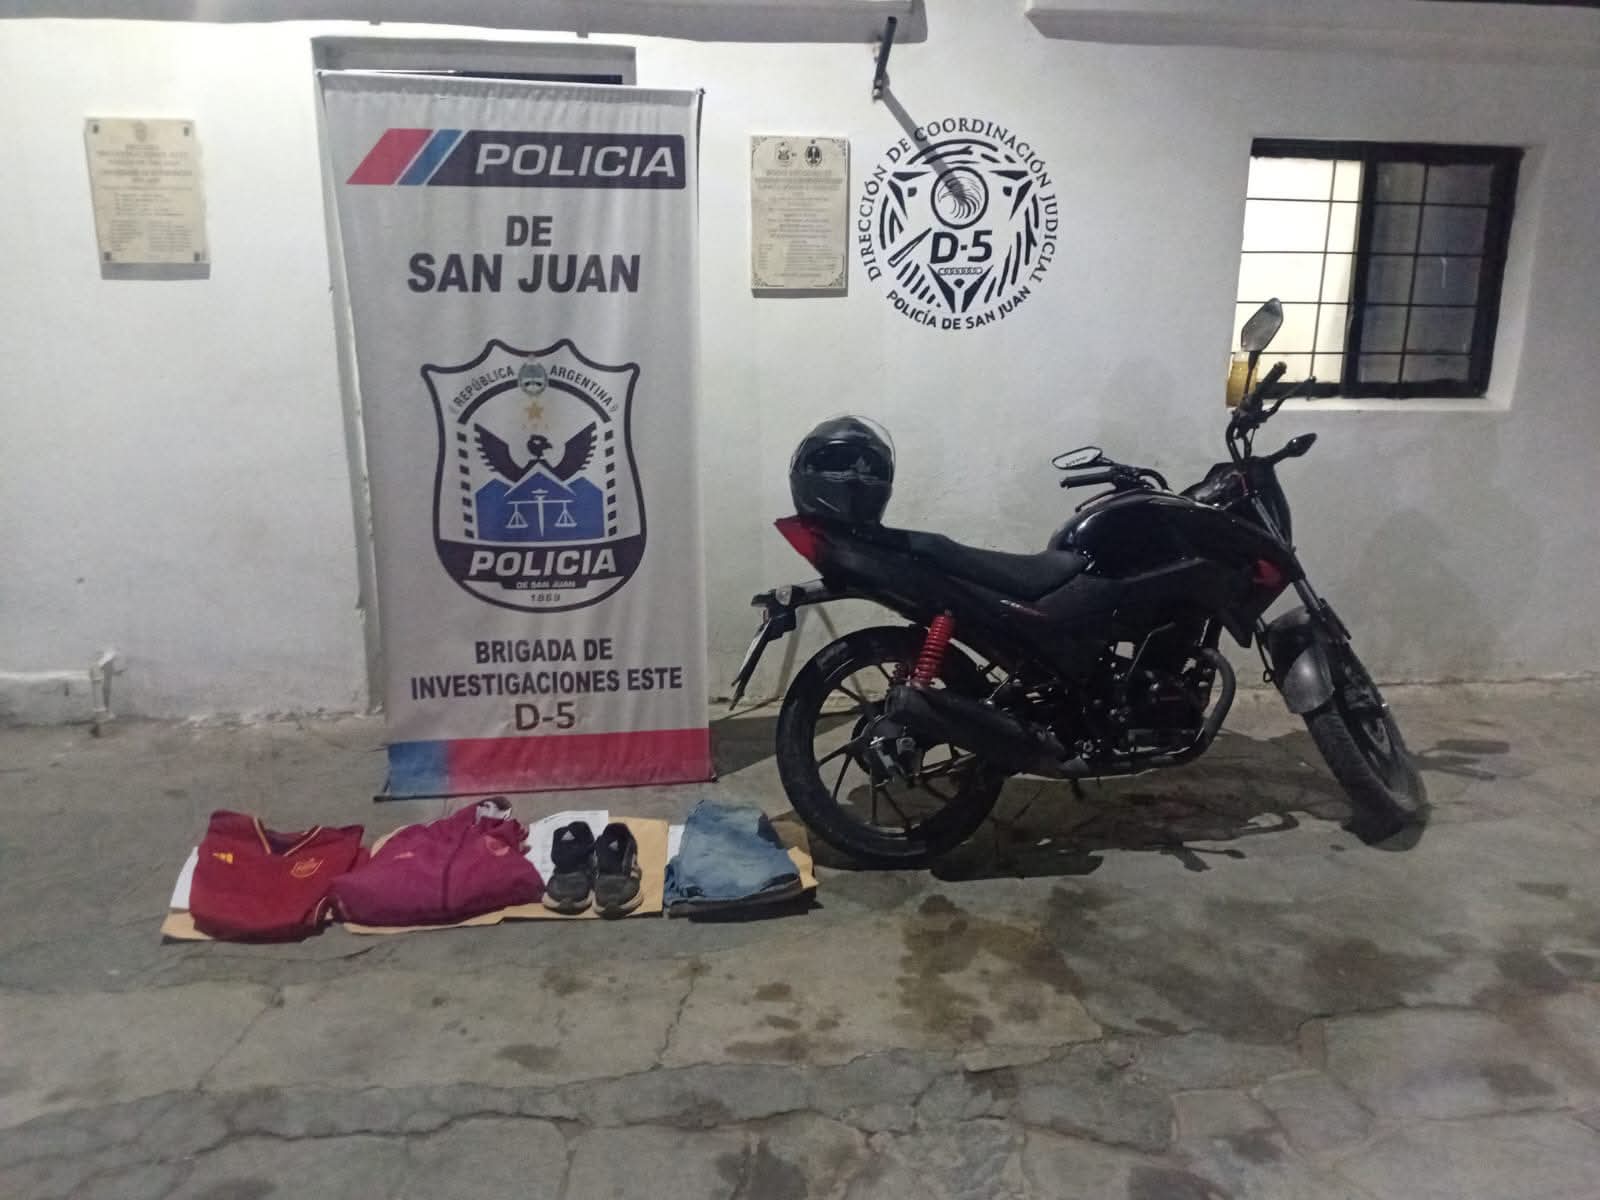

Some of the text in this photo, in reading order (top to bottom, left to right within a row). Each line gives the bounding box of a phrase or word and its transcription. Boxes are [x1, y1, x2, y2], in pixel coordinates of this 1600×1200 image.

[475, 142, 676, 178] POLICIA
[858, 165, 888, 282] DIRECCIÓN
[886, 138, 912, 164] DE
[913, 117, 1052, 189] COORDINACIÓN
[1029, 193, 1059, 283] JUDICIAL
[505, 215, 553, 248] DE
[929, 229, 993, 264] D-5
[407, 252, 641, 294] SAN JUAN
[886, 285, 1032, 330] POLICÍA DE SAN JUAN
[550, 364, 613, 407] ARGENTINA
[468, 548, 617, 577] POLICIA
[474, 638, 613, 664] BRIGADA DE
[410, 666, 683, 700] INVESTIGACIONES ESTE
[515, 701, 576, 731] D-5
